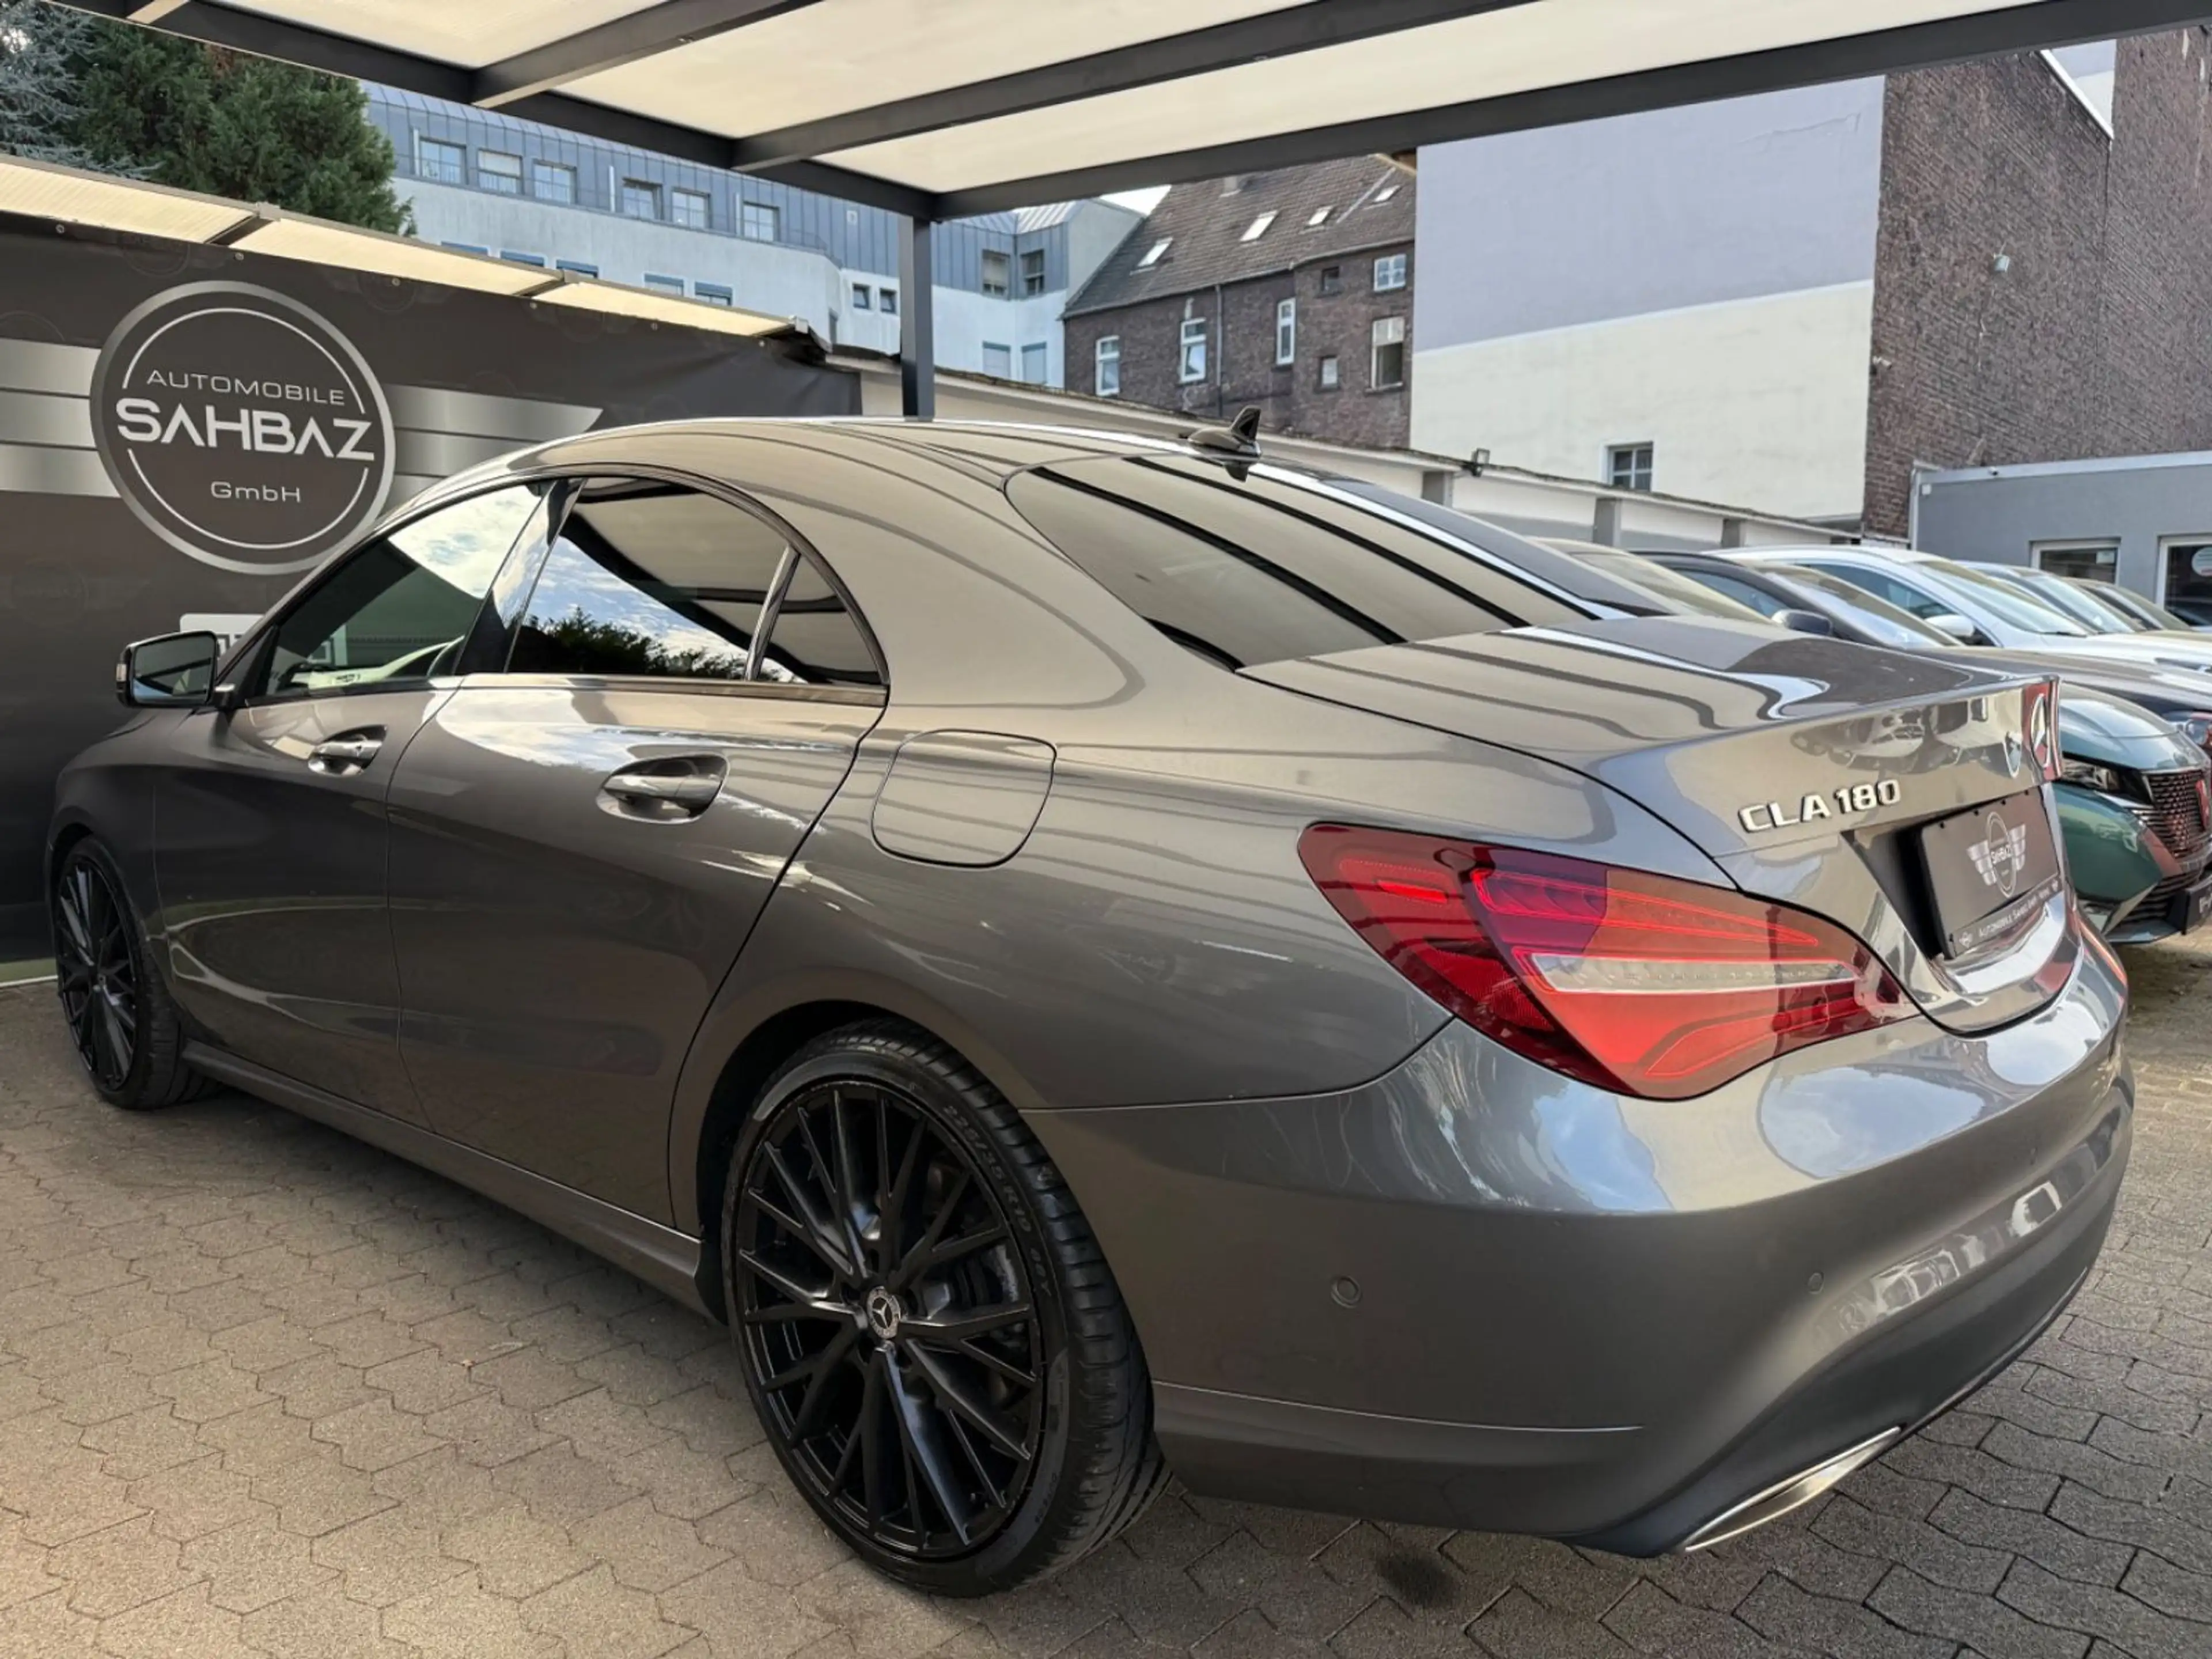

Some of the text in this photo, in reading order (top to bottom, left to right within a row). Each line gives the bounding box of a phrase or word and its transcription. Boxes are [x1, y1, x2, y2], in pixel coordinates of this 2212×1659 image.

[146, 369, 344, 406] AUTOMOBILE
[116, 397, 375, 461] SAHBAZ
[210, 480, 301, 503] GmbH
[1737, 779, 1901, 834] CLA 180
